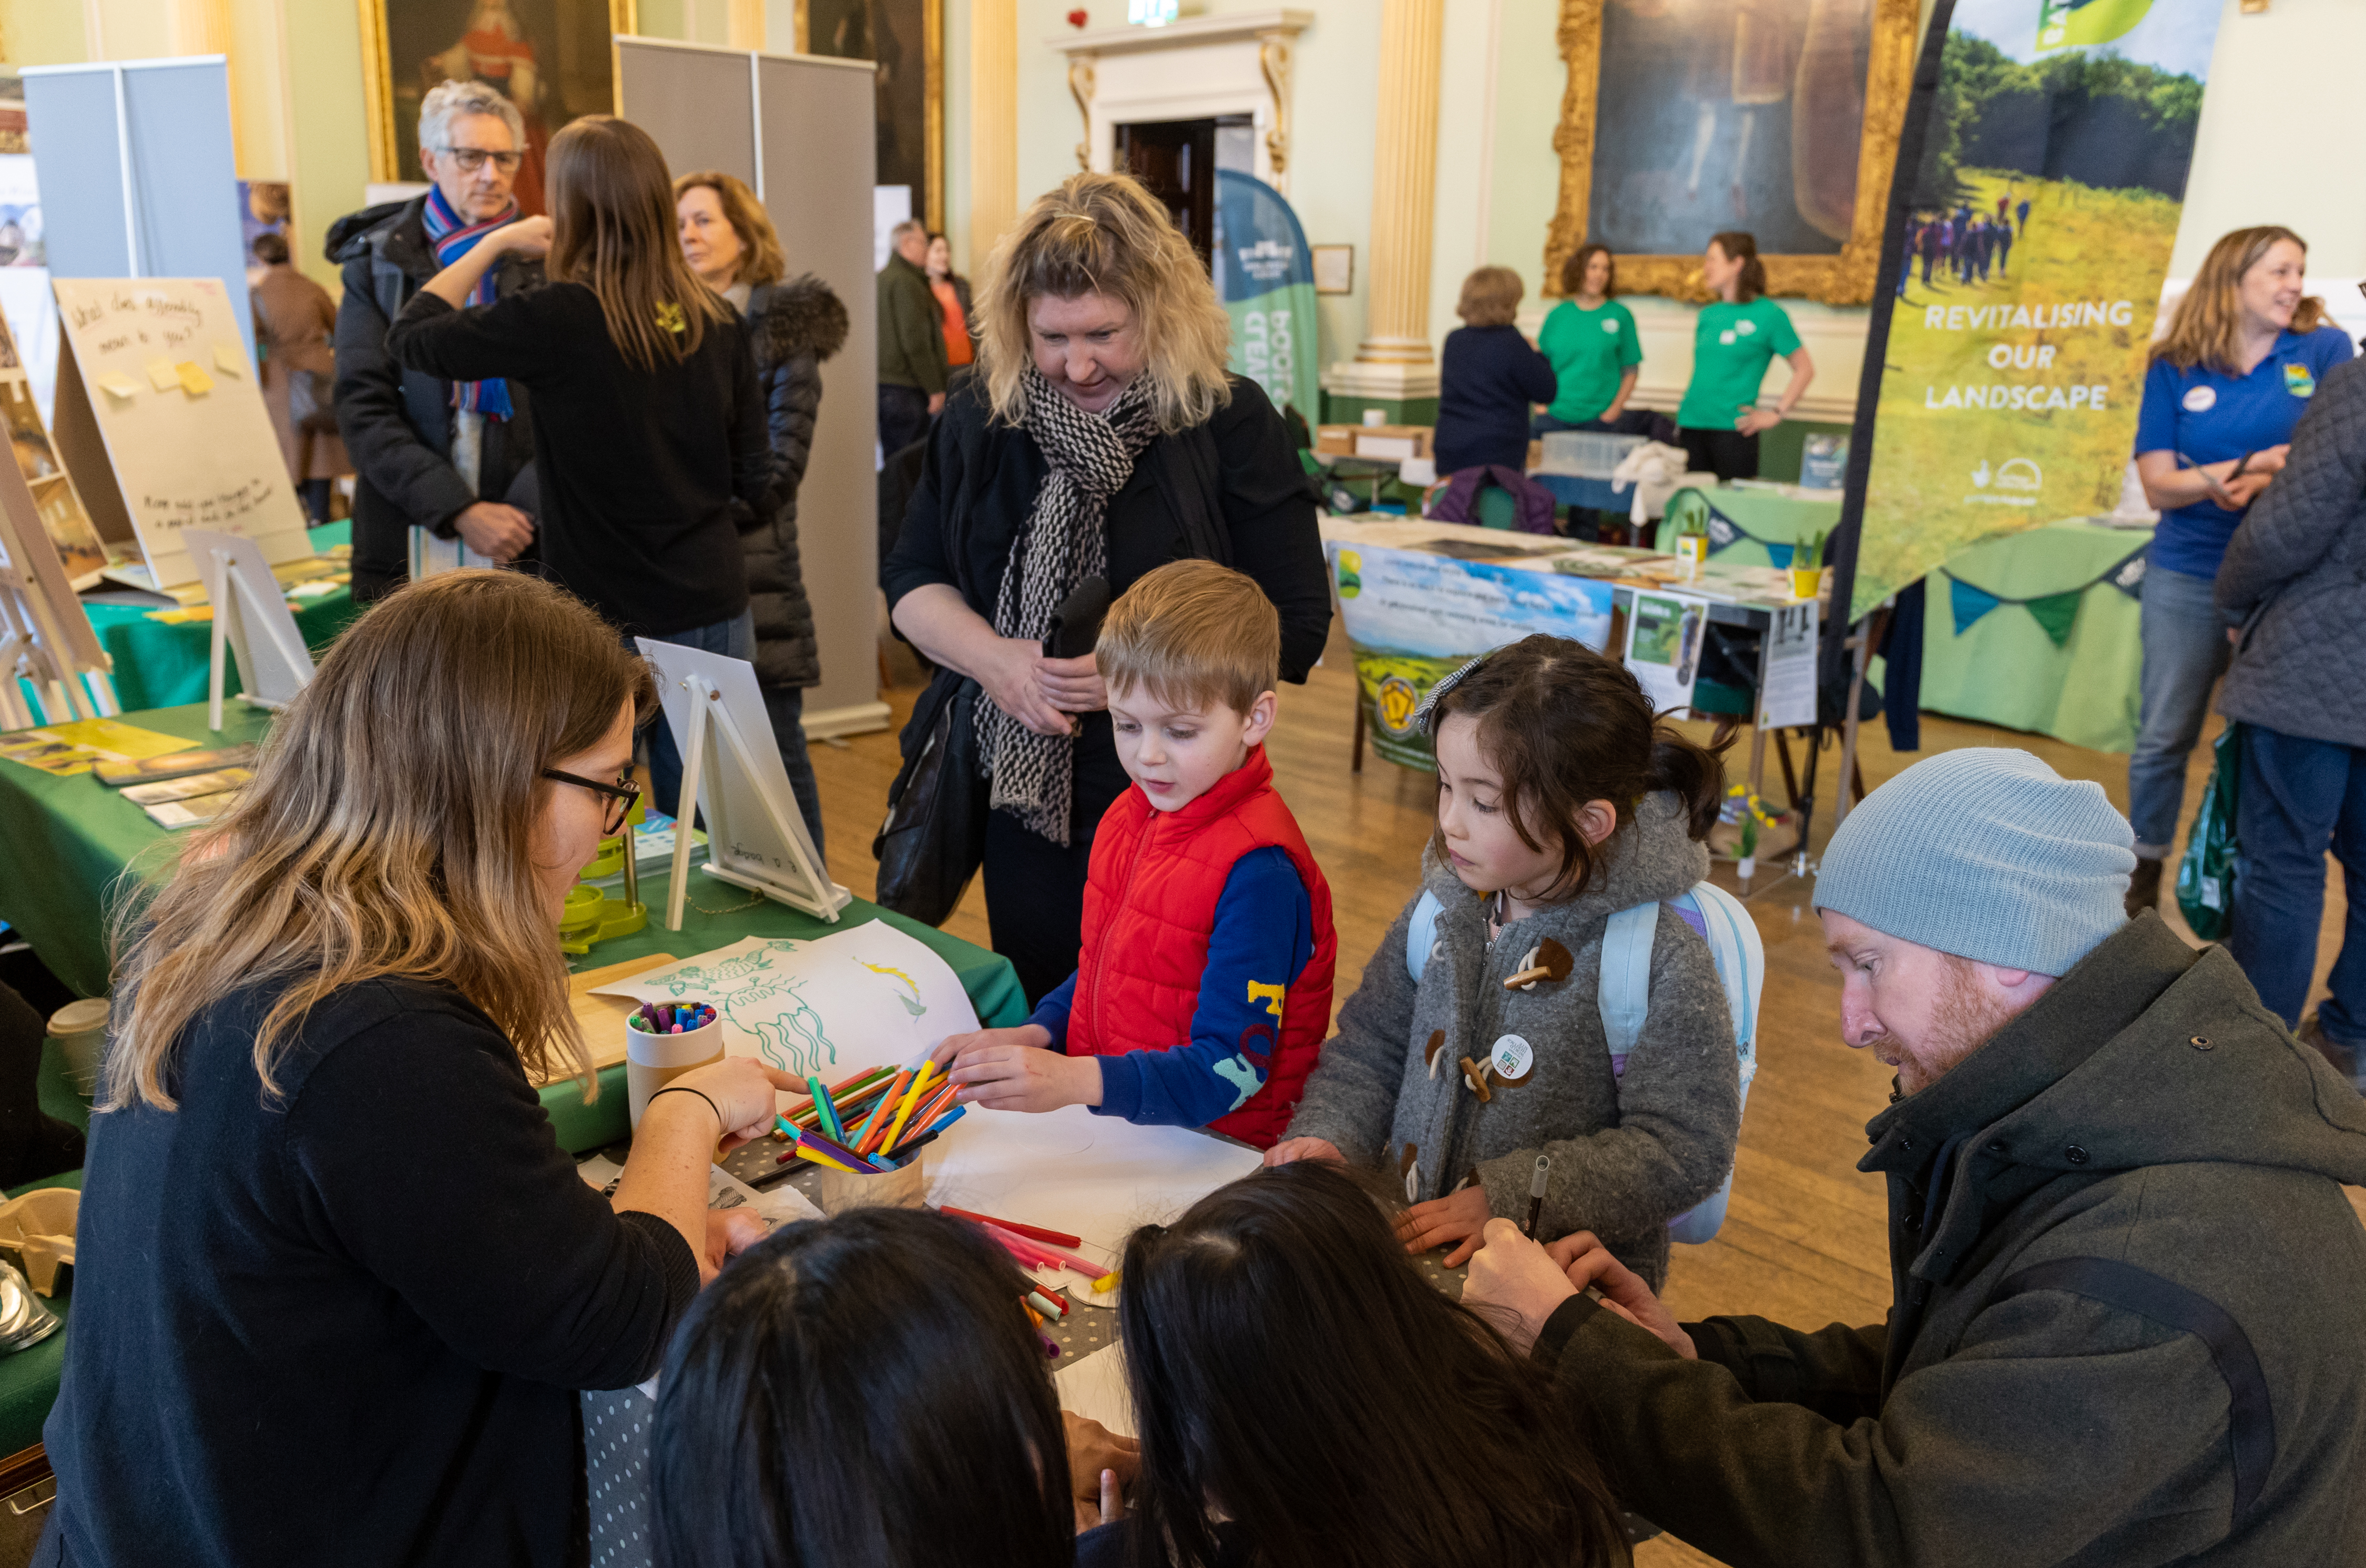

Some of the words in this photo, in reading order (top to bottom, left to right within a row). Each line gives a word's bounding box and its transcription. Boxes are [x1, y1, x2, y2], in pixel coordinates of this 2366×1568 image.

[1924, 300, 2133, 331] REVITALISING
[1988, 343, 2057, 370] OUR
[1924, 384, 2109, 411] LANDSCAPE
[1506, 1037, 1527, 1054] HERITAGE
[1510, 1044, 1525, 1058] WORLD
[1519, 1042, 1529, 1051] SITE
